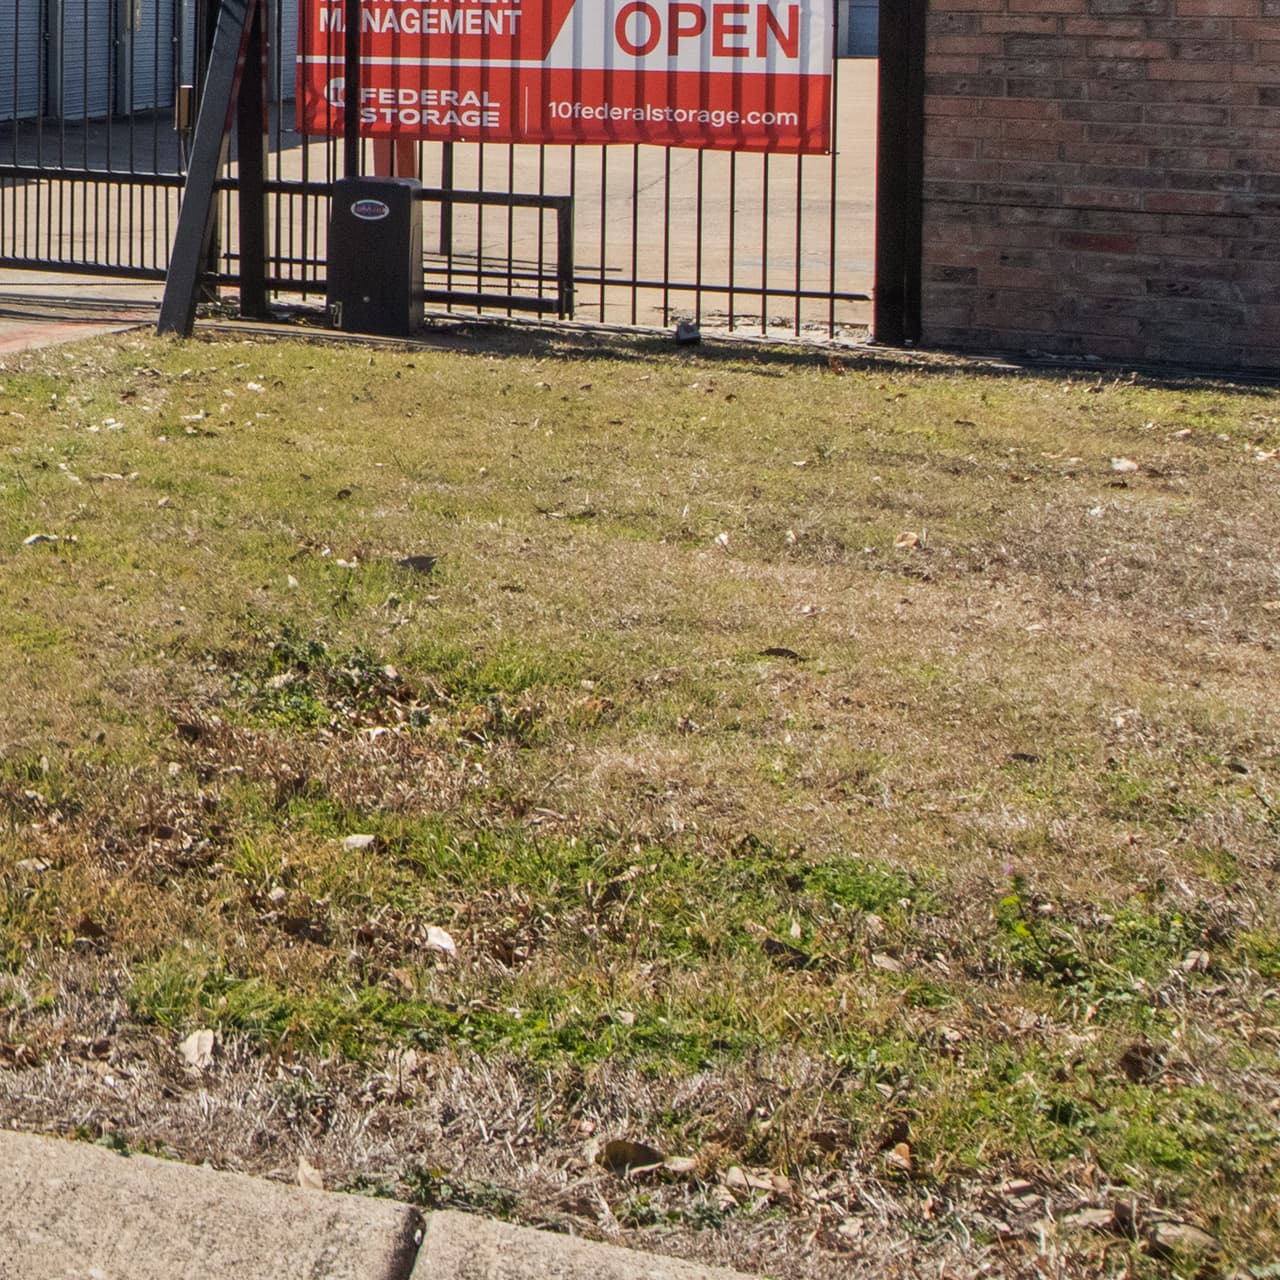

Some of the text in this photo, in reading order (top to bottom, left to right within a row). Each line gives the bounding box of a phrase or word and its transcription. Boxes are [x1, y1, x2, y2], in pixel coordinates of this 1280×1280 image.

[319, 8, 522, 35] MNAGEMENT
[615, 1, 800, 58] OPEN
[360, 88, 501, 108] FEDERAL
[360, 108, 500, 128] STORAGE
[548, 101, 799, 128] 10federalstorage.com
